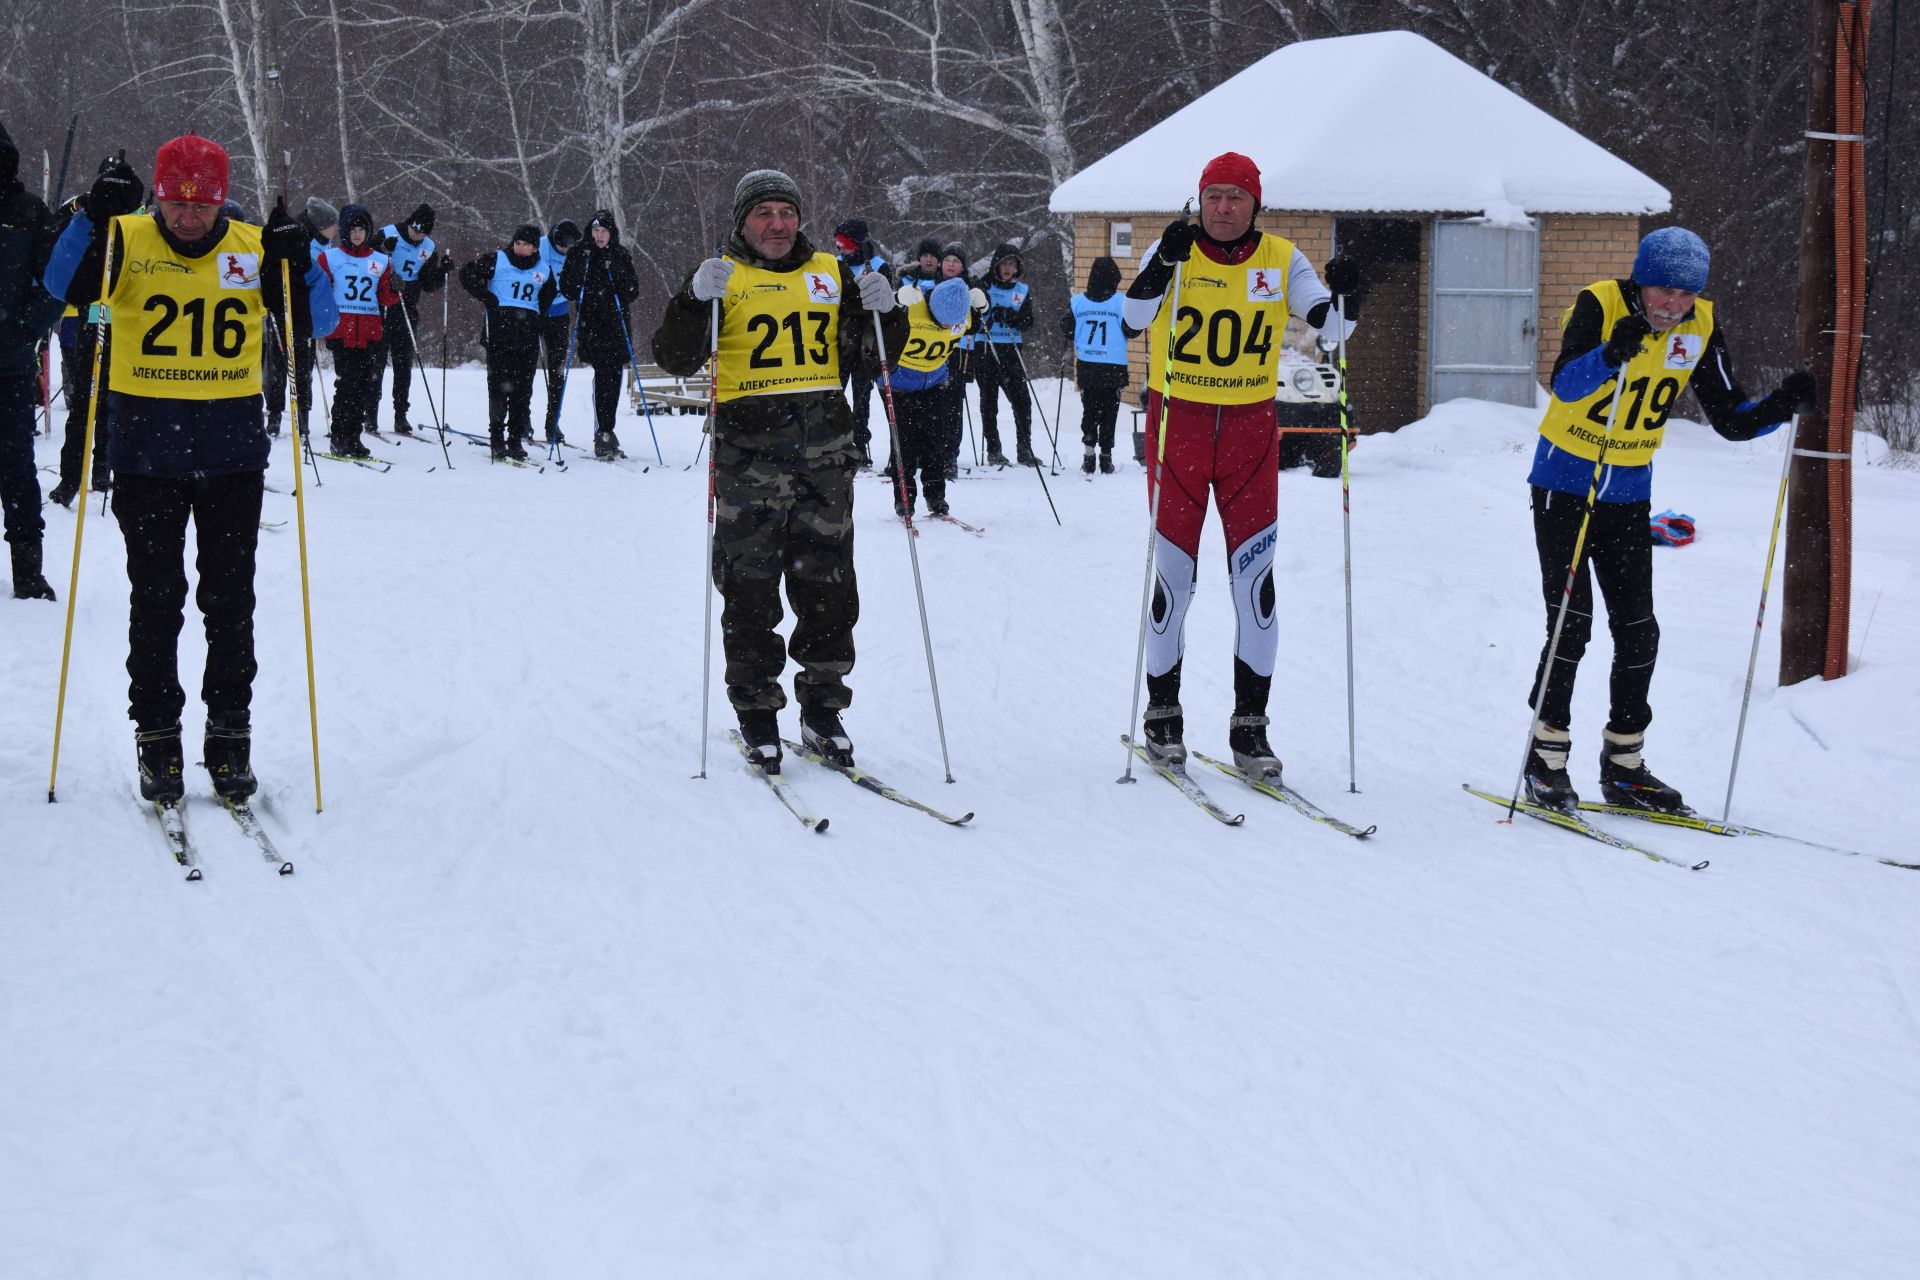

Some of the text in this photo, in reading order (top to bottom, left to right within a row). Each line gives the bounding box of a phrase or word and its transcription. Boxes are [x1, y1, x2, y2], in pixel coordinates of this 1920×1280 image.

[402, 260, 416, 278] 5
[344, 275, 373, 303] 32
[511, 281, 535, 302] 18
[141, 294, 249, 359] 216
[1085, 320, 1107, 346] 71
[1173, 305, 1273, 368] 204
[747, 311, 831, 370] 213
[132, 366, 250, 381] АЛЕКСЕЕВСКИЙ РАЙОН
[1170, 371, 1269, 388] АЛЕКСЕЕВСКИЙ РАЙОН
[1586, 370, 1679, 431] 219
[1567, 424, 1657, 450] АЛЕКСЕВСКИЙ РАЙ
[1239, 525, 1278, 574] BRIK
